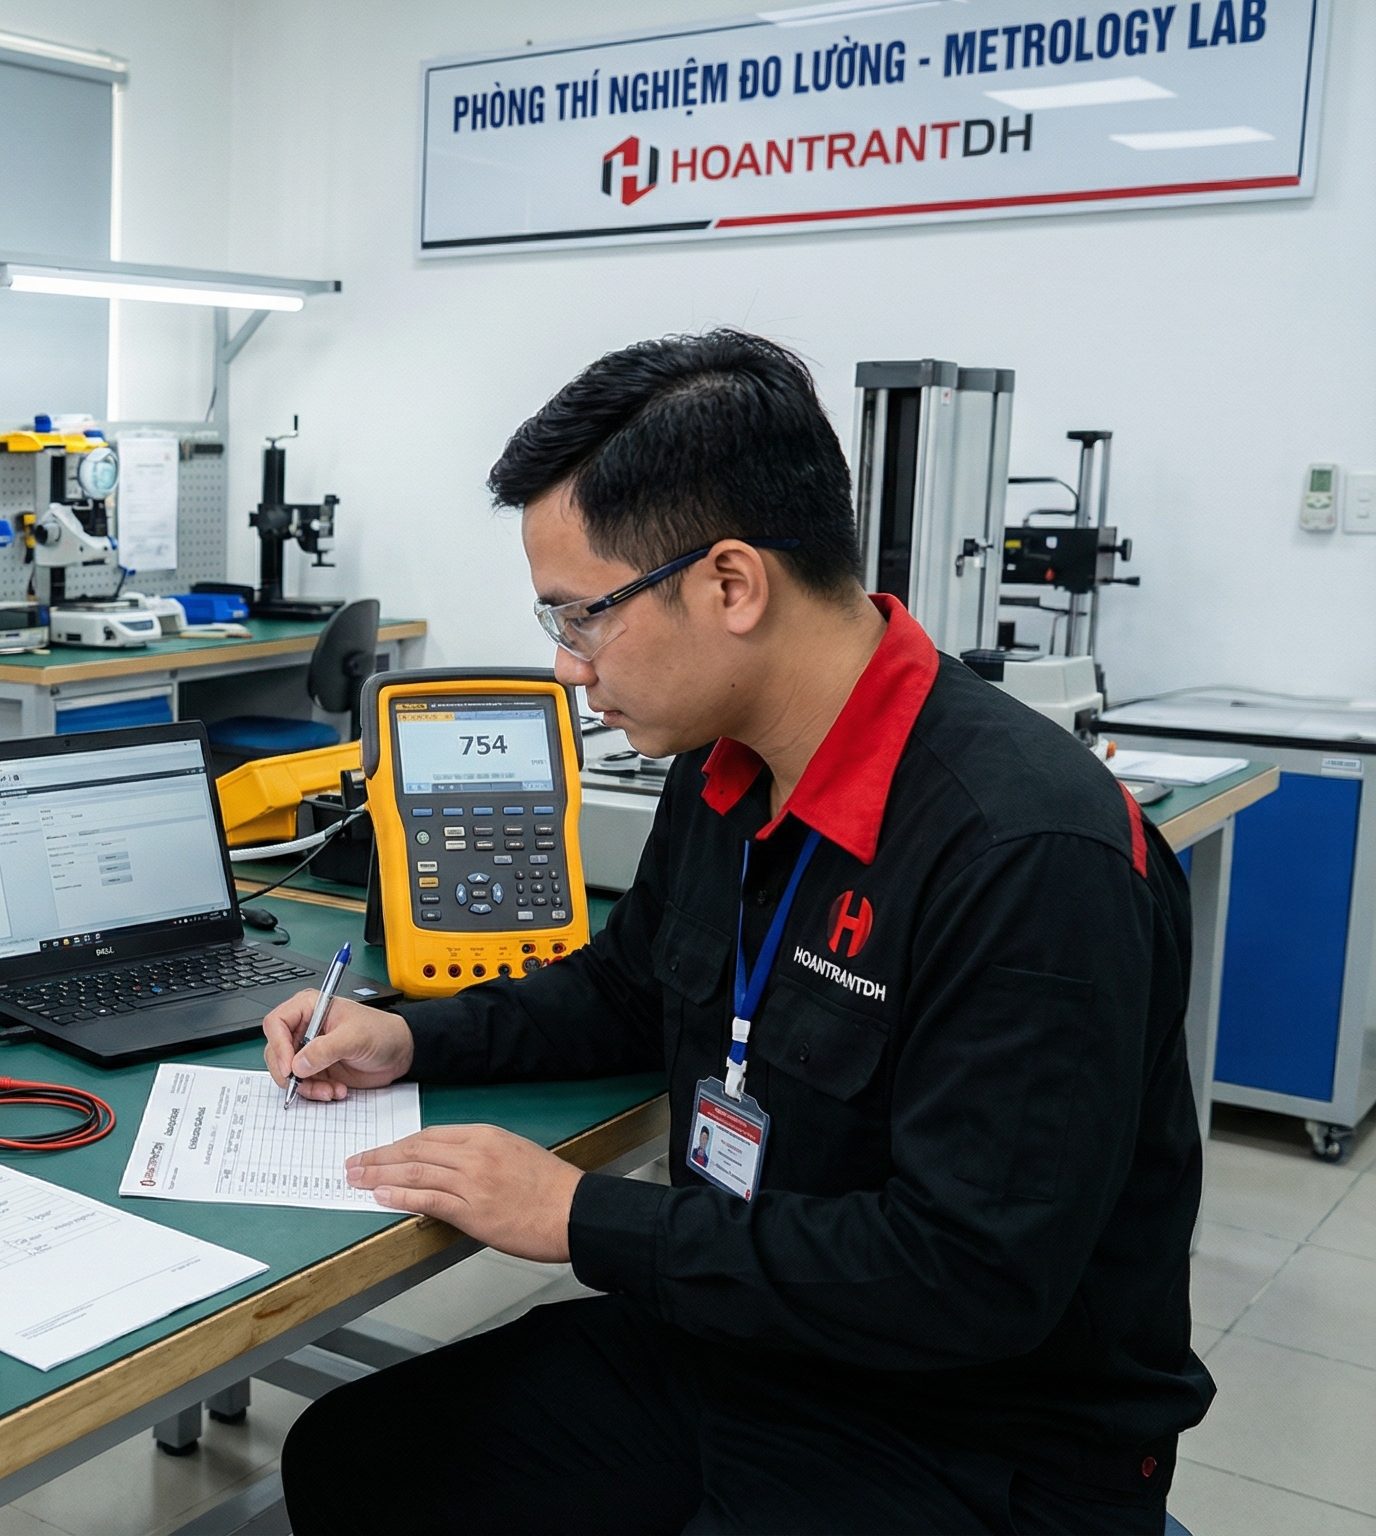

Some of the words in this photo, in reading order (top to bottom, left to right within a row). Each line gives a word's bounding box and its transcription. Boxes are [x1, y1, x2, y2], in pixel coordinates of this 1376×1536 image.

[452, 82, 545, 133] PHÒNG
[555, 69, 601, 121] THÍ
[609, 57, 729, 116] NGHIỆM
[739, 55, 782, 100] ĐO
[794, 36, 906, 94] LƯỜNG
[943, 5, 1176, 78] METROLOGY
[1188, 0, 1267, 49] LAB
[671, 113, 1034, 184] HOANTRANTDH
[459, 734, 508, 756] 754
[793, 946, 887, 1002] HOANTRANTDH
